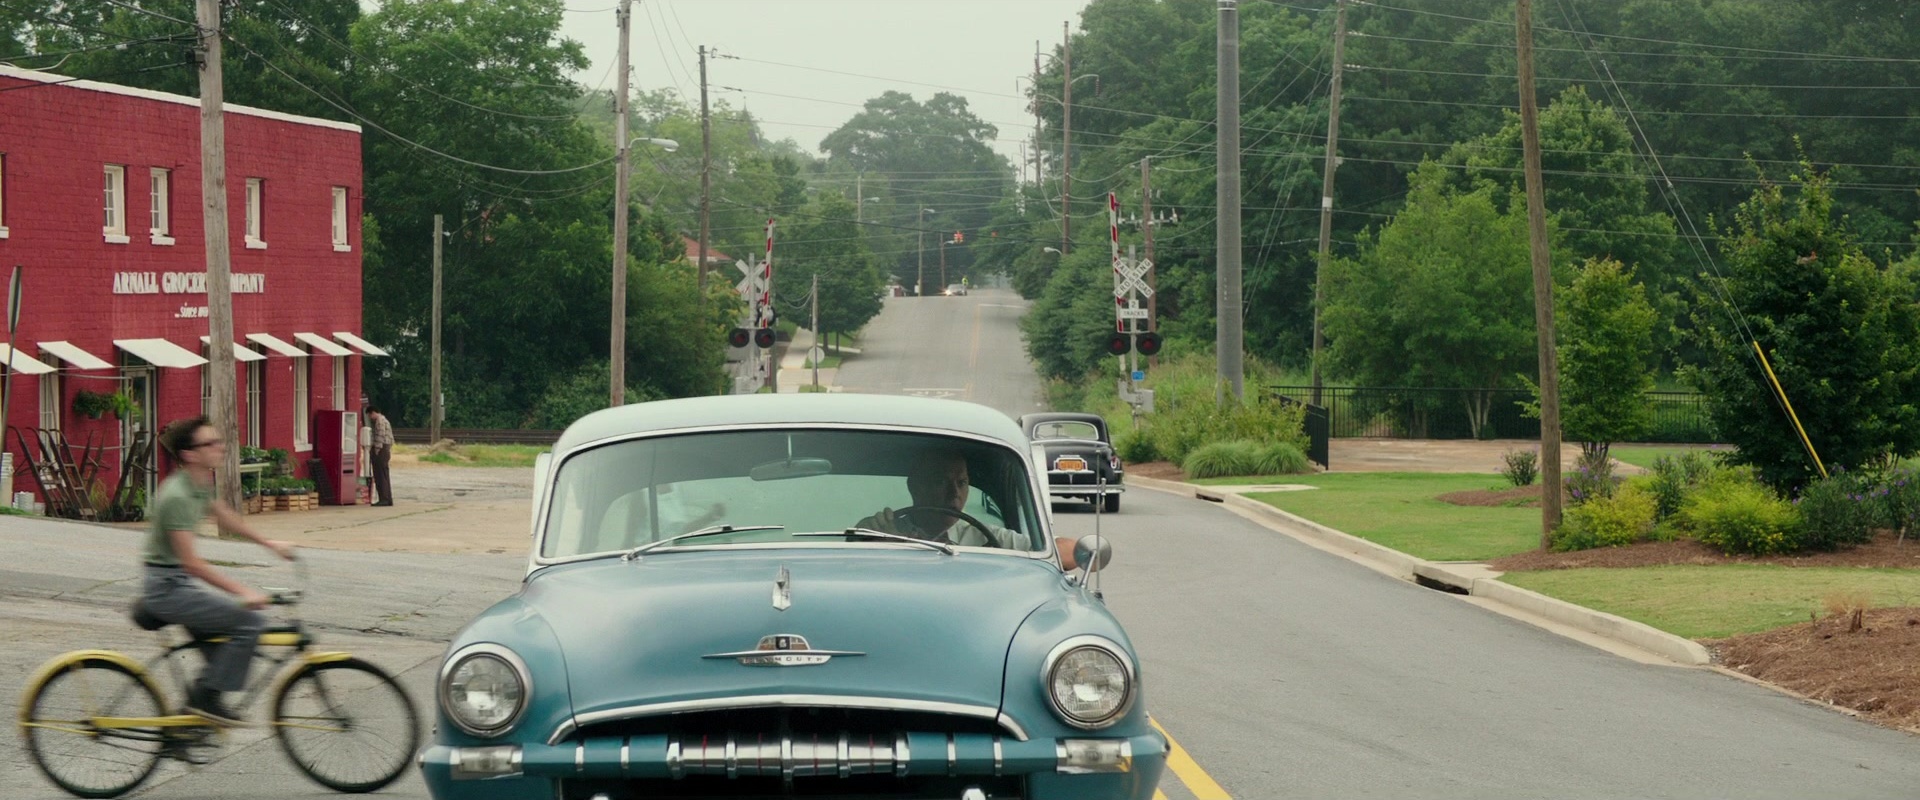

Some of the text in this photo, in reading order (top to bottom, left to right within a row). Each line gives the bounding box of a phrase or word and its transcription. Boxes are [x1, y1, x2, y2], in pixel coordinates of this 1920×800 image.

[113, 272, 159, 294] ARNALL
[1115, 260, 1151, 296] CROSSING
[743, 656, 824, 664] PLYMOUTH
